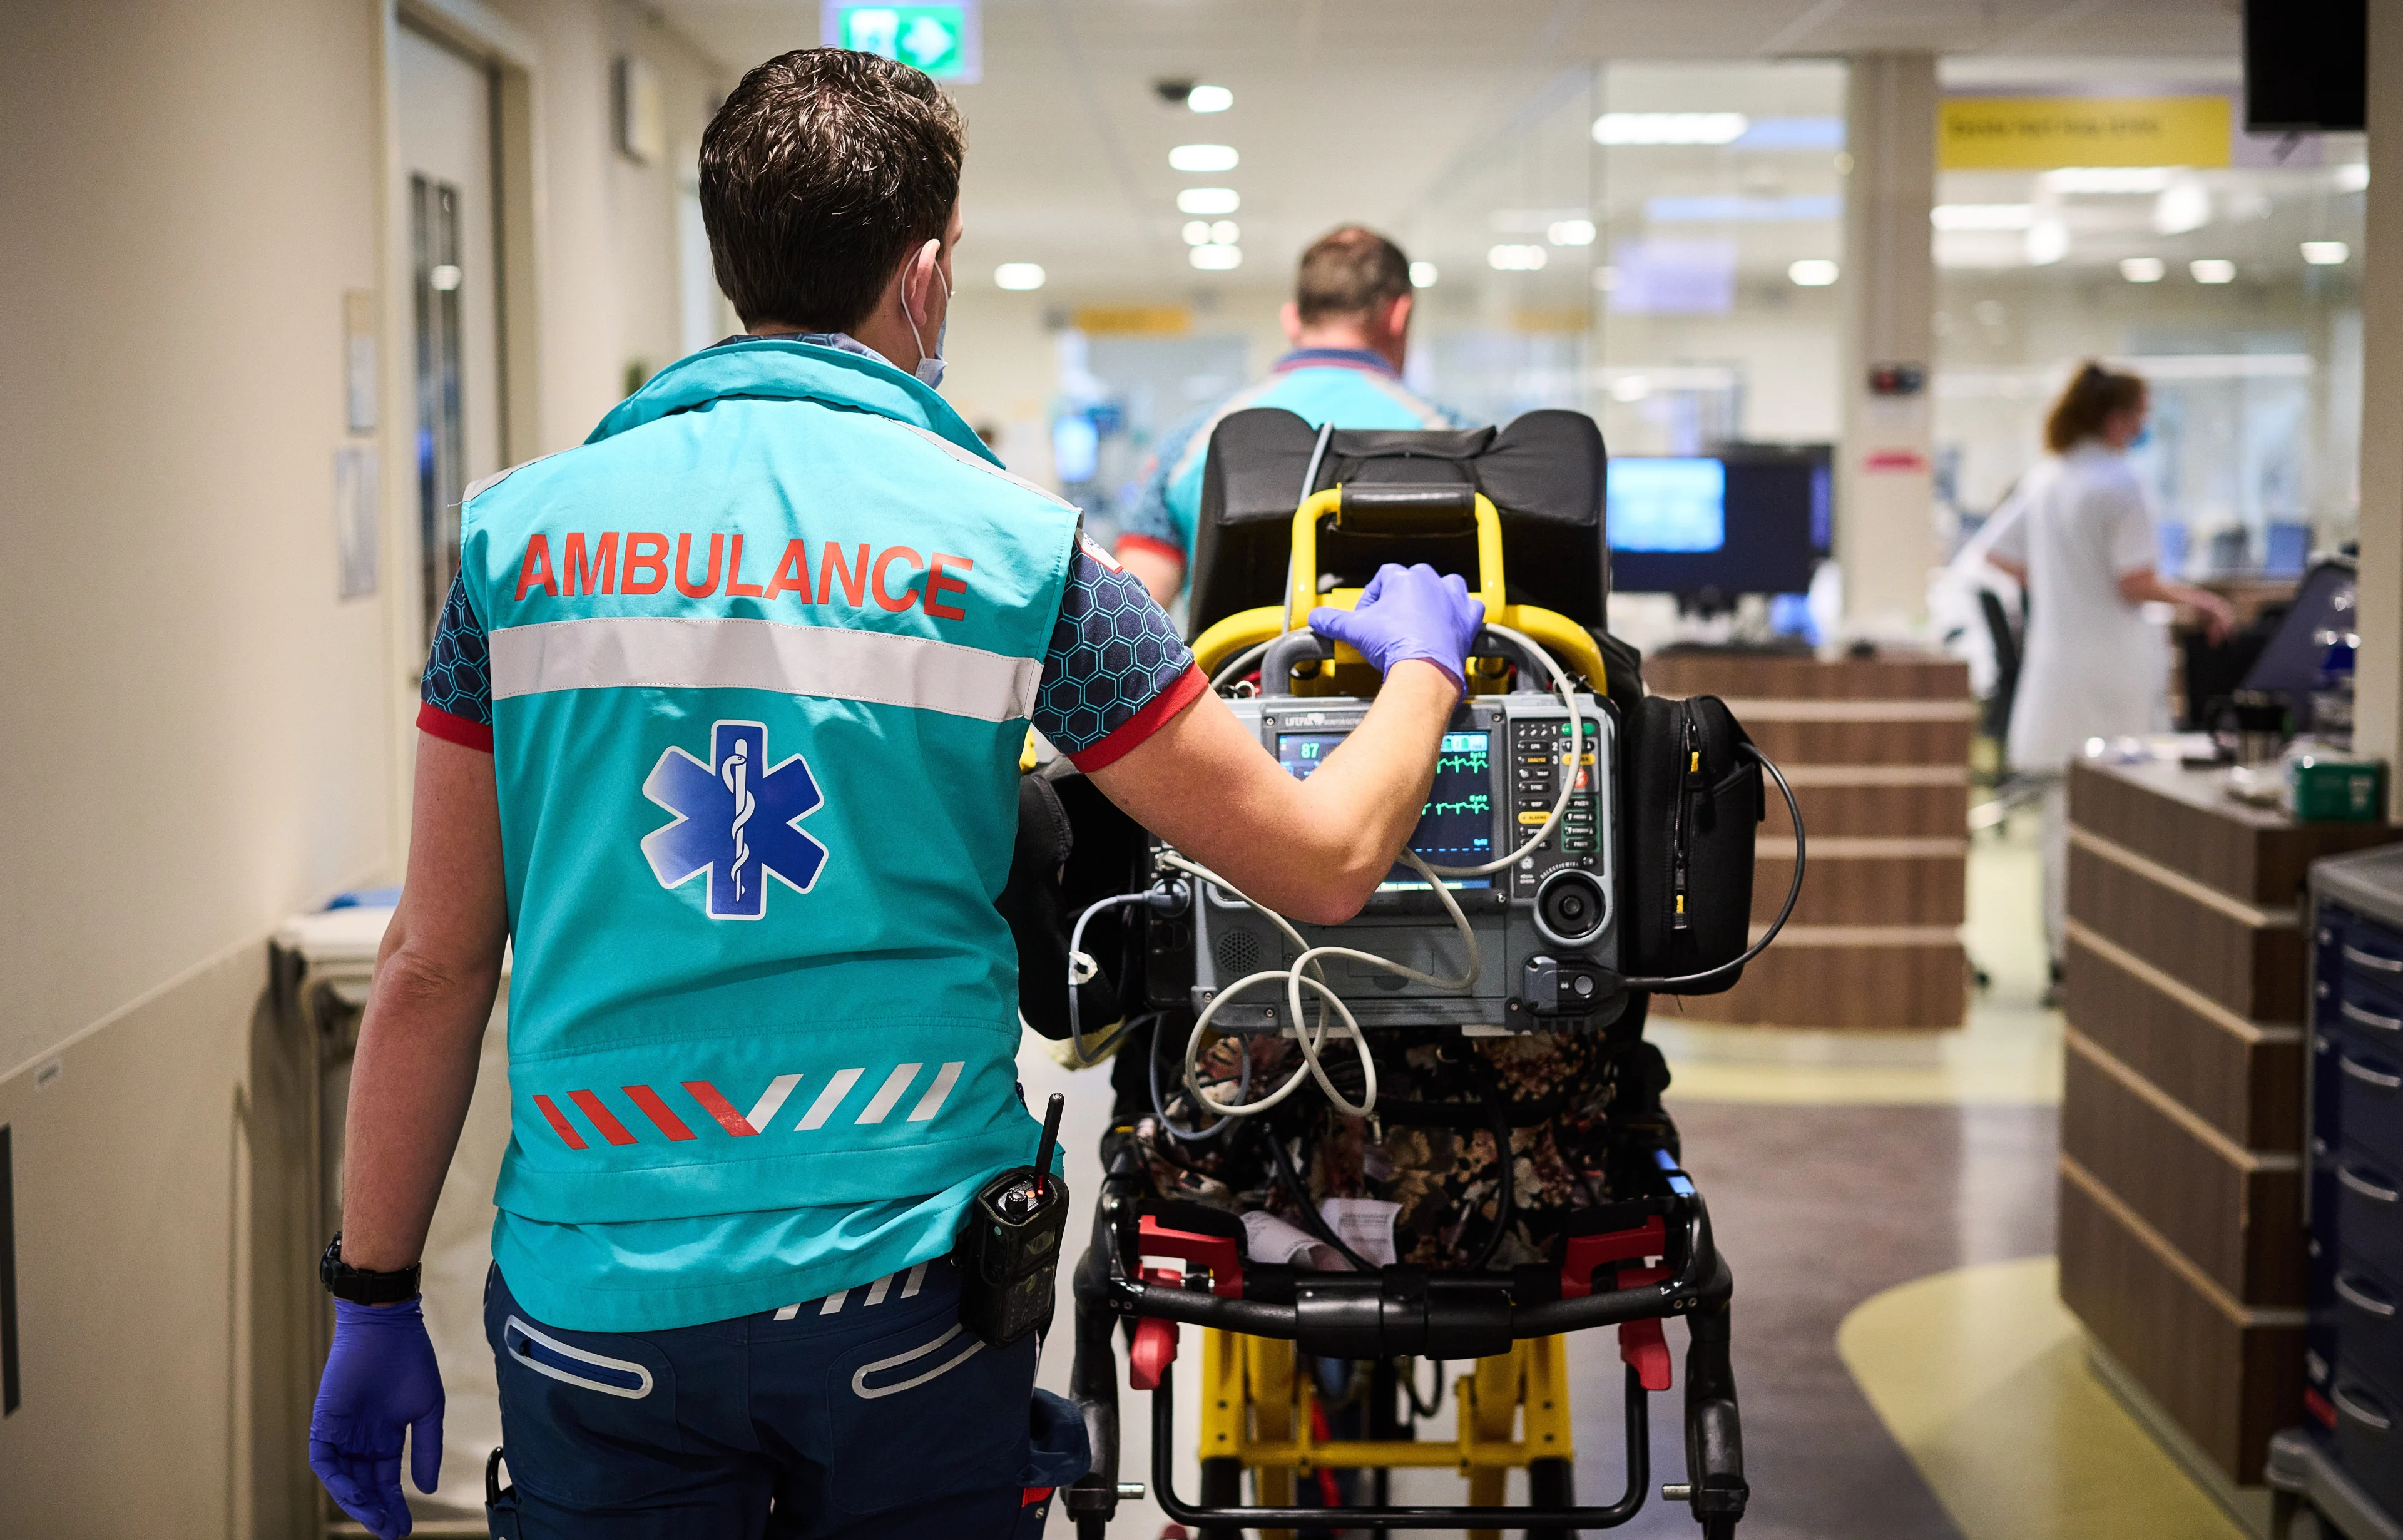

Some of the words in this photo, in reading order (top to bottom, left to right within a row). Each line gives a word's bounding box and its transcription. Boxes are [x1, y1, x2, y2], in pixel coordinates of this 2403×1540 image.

[514, 532, 974, 621] AMBULANCE
[1551, 725, 1556, 735] 1
[1302, 743, 1319, 758] 87
[1552, 742, 1558, 751] 2
[1553, 755, 1558, 764] 3
